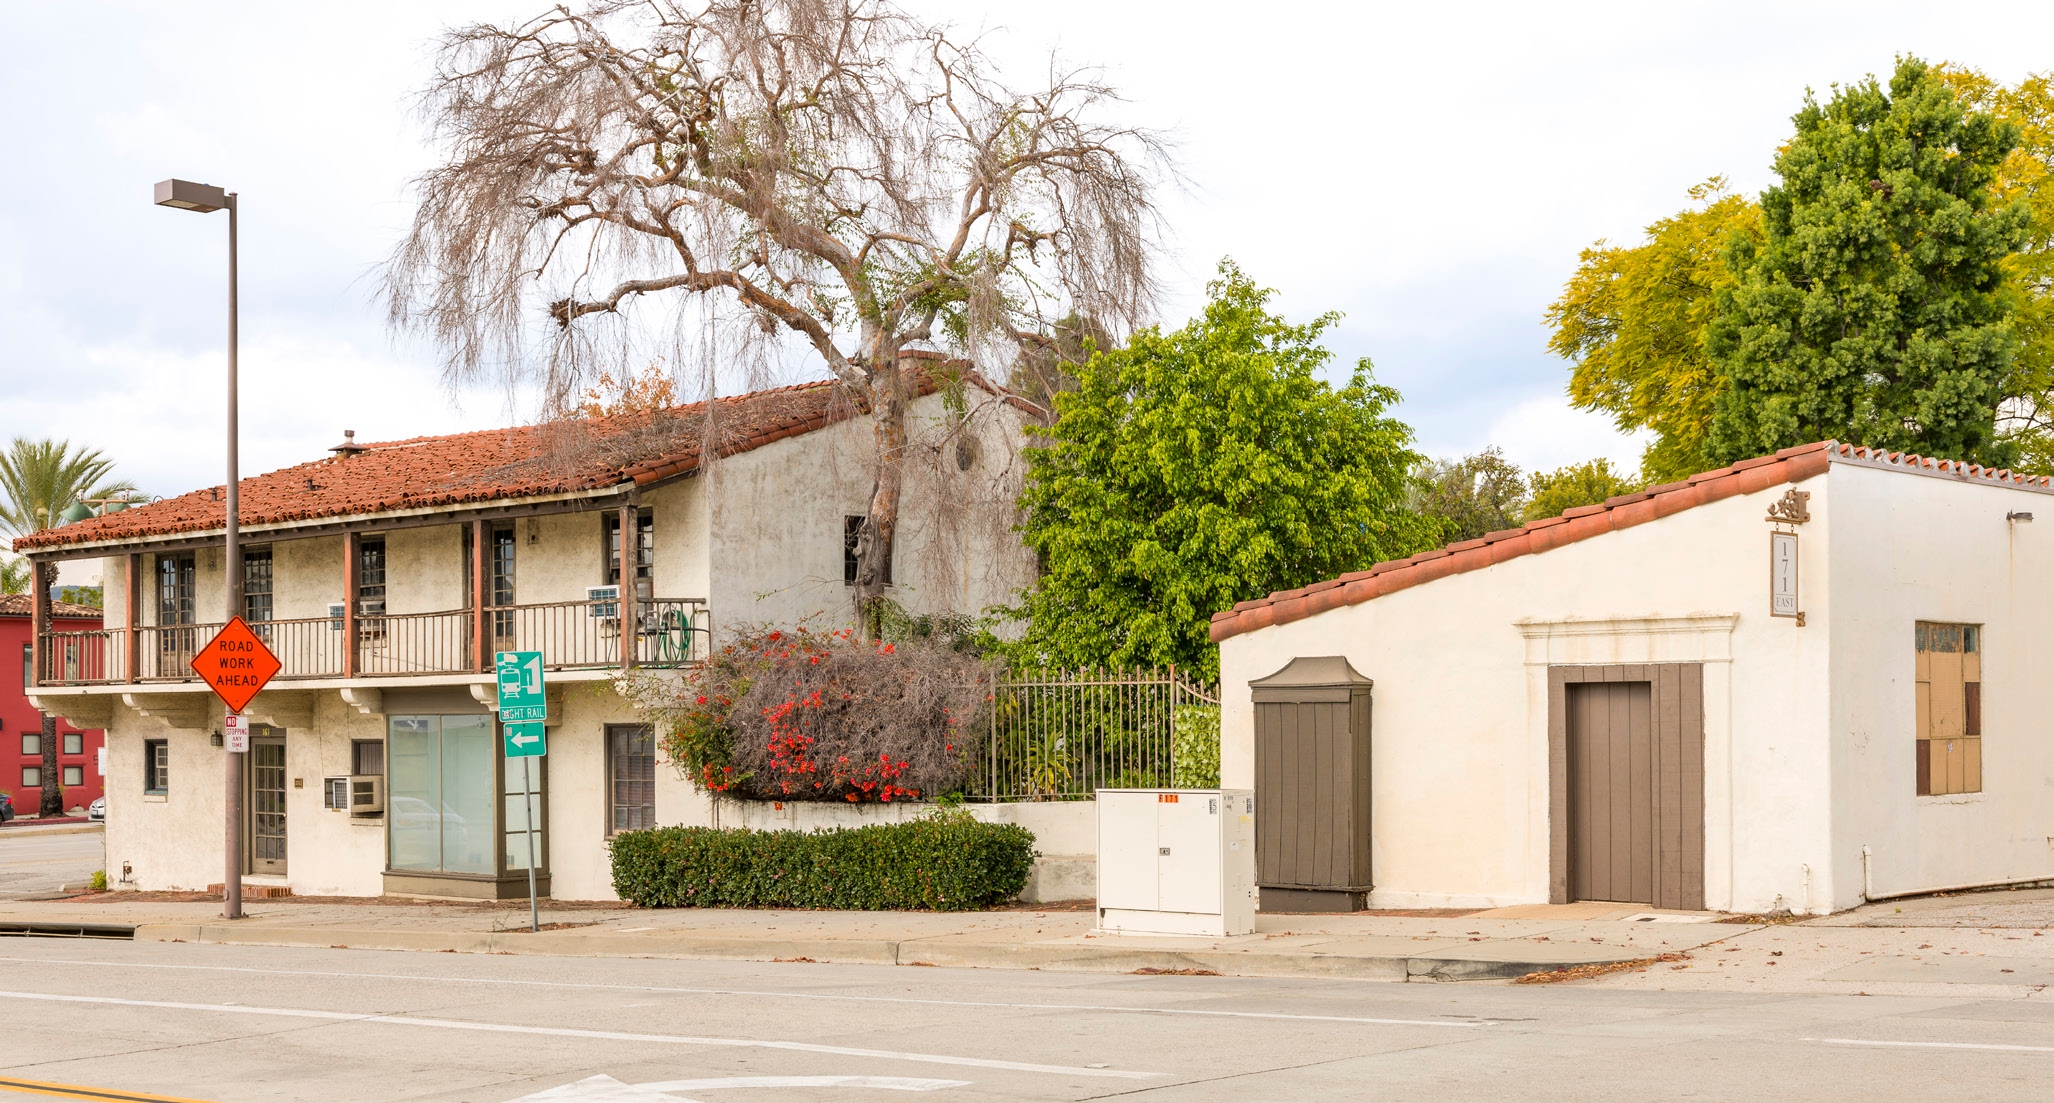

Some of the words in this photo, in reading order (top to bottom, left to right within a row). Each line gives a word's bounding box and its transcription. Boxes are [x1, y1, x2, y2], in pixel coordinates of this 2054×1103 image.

[1776, 596, 1794, 607] EAST
[220, 640, 254, 652] ROAD
[219, 657, 254, 669] WORK
[215, 675, 259, 686] AHEAD
[502, 708, 524, 720] GHT
[527, 707, 545, 719] RAIL
[227, 717, 236, 726] NO
[226, 728, 247, 736] STOPPING
